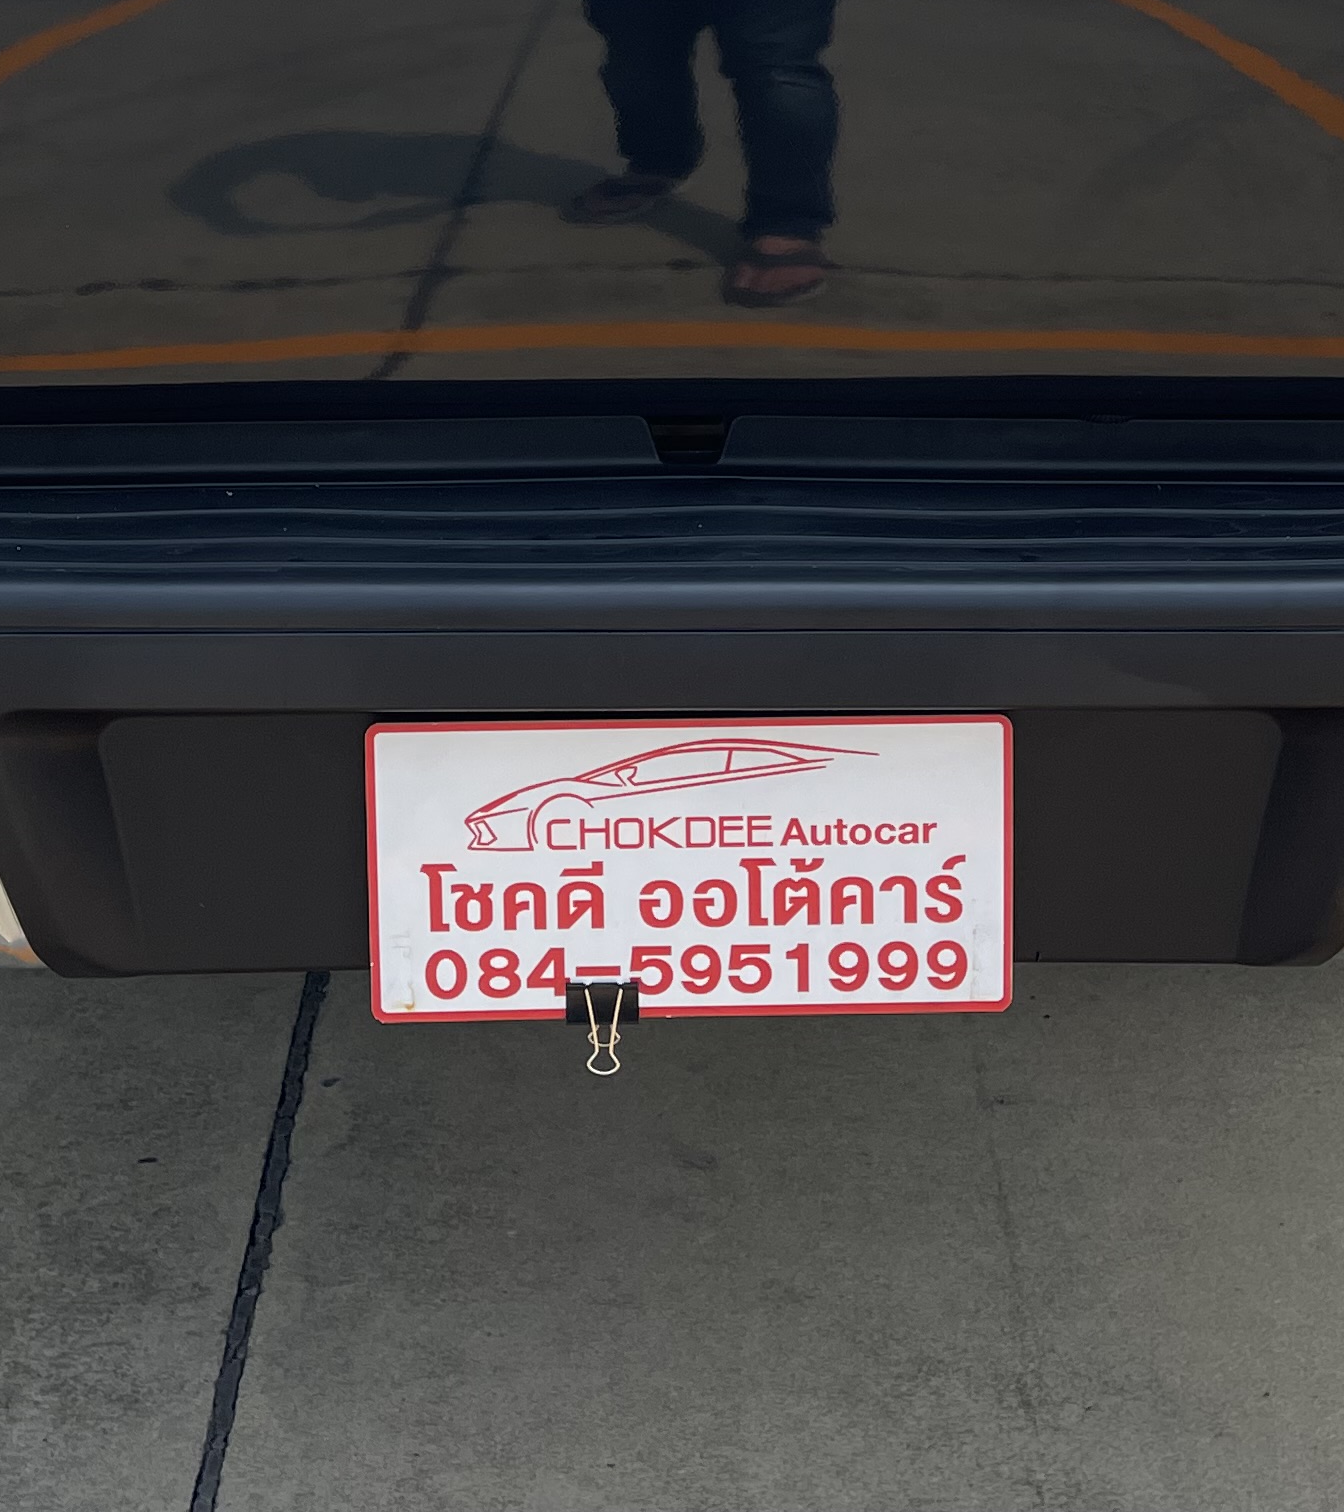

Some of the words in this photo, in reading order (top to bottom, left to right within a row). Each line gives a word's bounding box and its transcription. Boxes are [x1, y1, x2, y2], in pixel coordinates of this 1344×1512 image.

[546, 815, 773, 851] CHOKDEE
[780, 816, 938, 849] Autocar
[420, 860, 605, 934] โชคดี
[638, 854, 966, 929] ออโต้คาร์
[423, 939, 969, 1000] 084-5951999
